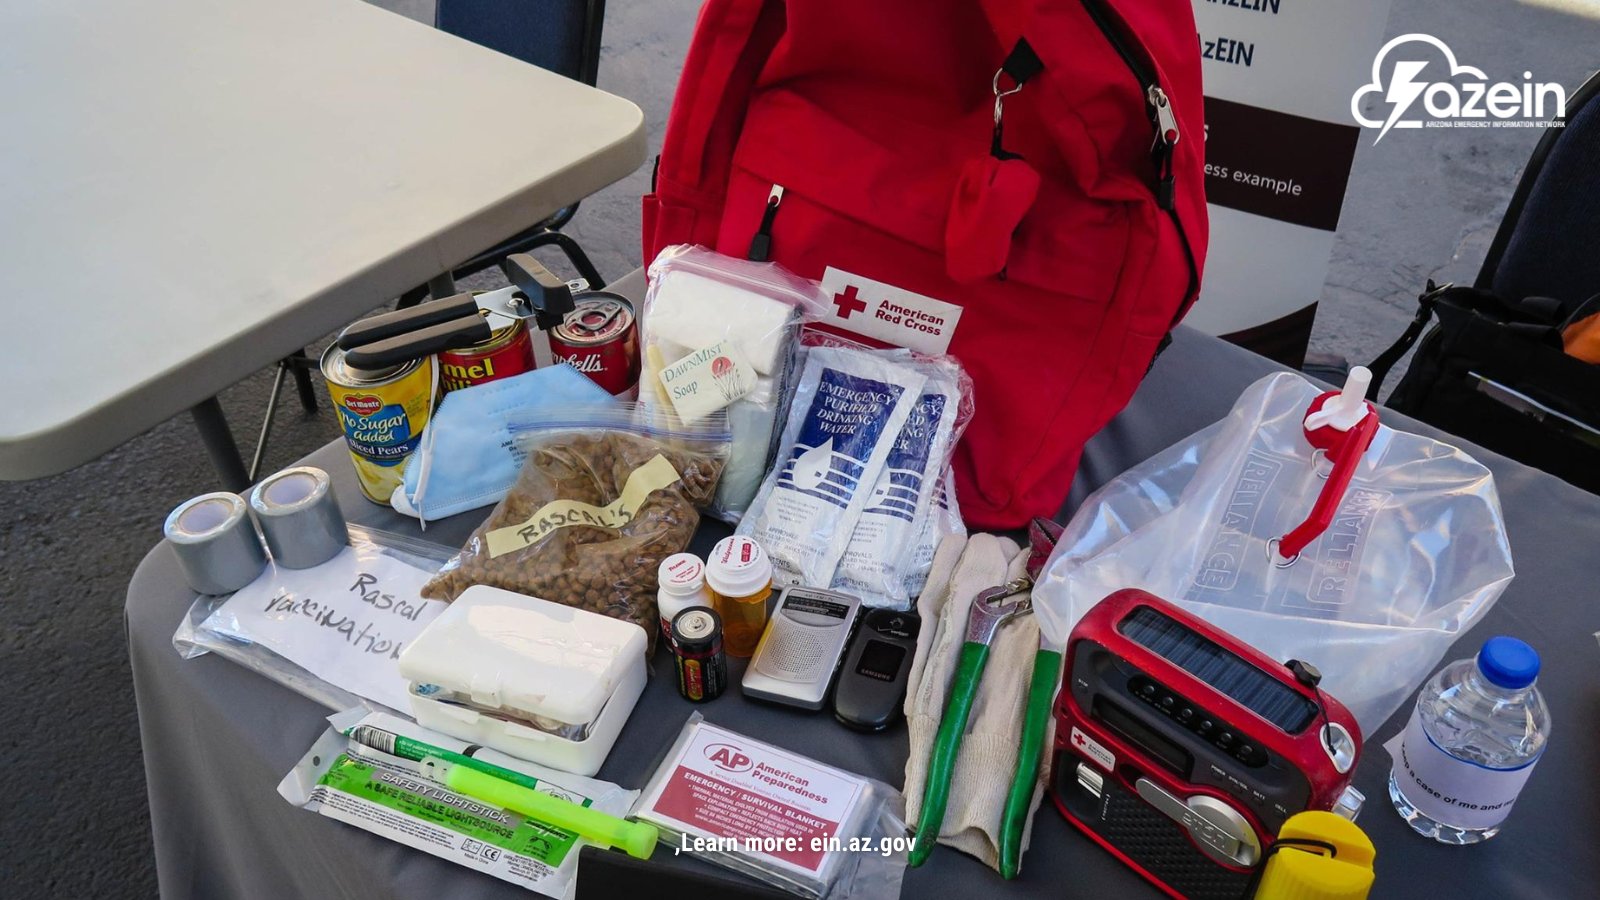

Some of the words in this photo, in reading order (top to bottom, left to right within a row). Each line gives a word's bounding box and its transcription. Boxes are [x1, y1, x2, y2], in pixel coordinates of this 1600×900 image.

[1198, 33, 1255, 67] zEIN
[1233, 170, 1302, 196] example
[875, 309, 902, 324] Red
[904, 318, 941, 336] Cross
[879, 300, 944, 326] American
[673, 380, 698, 400] Soap
[820, 381, 896, 406] EMERGENCY
[817, 408, 873, 425] DRINKING
[824, 396, 877, 413] PURIFIED
[357, 413, 406, 434] Sugar
[820, 421, 857, 434] WATER
[377, 443, 409, 455] Pears
[517, 504, 632, 543] RASCAL'S
[349, 573, 428, 621] Rascal
[709, 747, 750, 769] AP
[751, 769, 829, 805] Preparedness
[755, 762, 810, 787] American
[381, 772, 433, 795] SAFETY
[432, 790, 511, 824] LIGHTSTICK
[683, 772, 737, 797] EMERGENCY
[741, 793, 783, 814] SURVIVAL
[785, 807, 828, 830] BLANKET
[1416, 778, 1441, 799] case
[1443, 796, 1457, 805] of
[1459, 801, 1478, 810] me
[1480, 803, 1503, 811] and
[364, 781, 373, 790] A
[374, 782, 400, 799] SAFE
[399, 793, 444, 814] RELIABLE
[444, 805, 515, 839] LIGHTSOURCE
